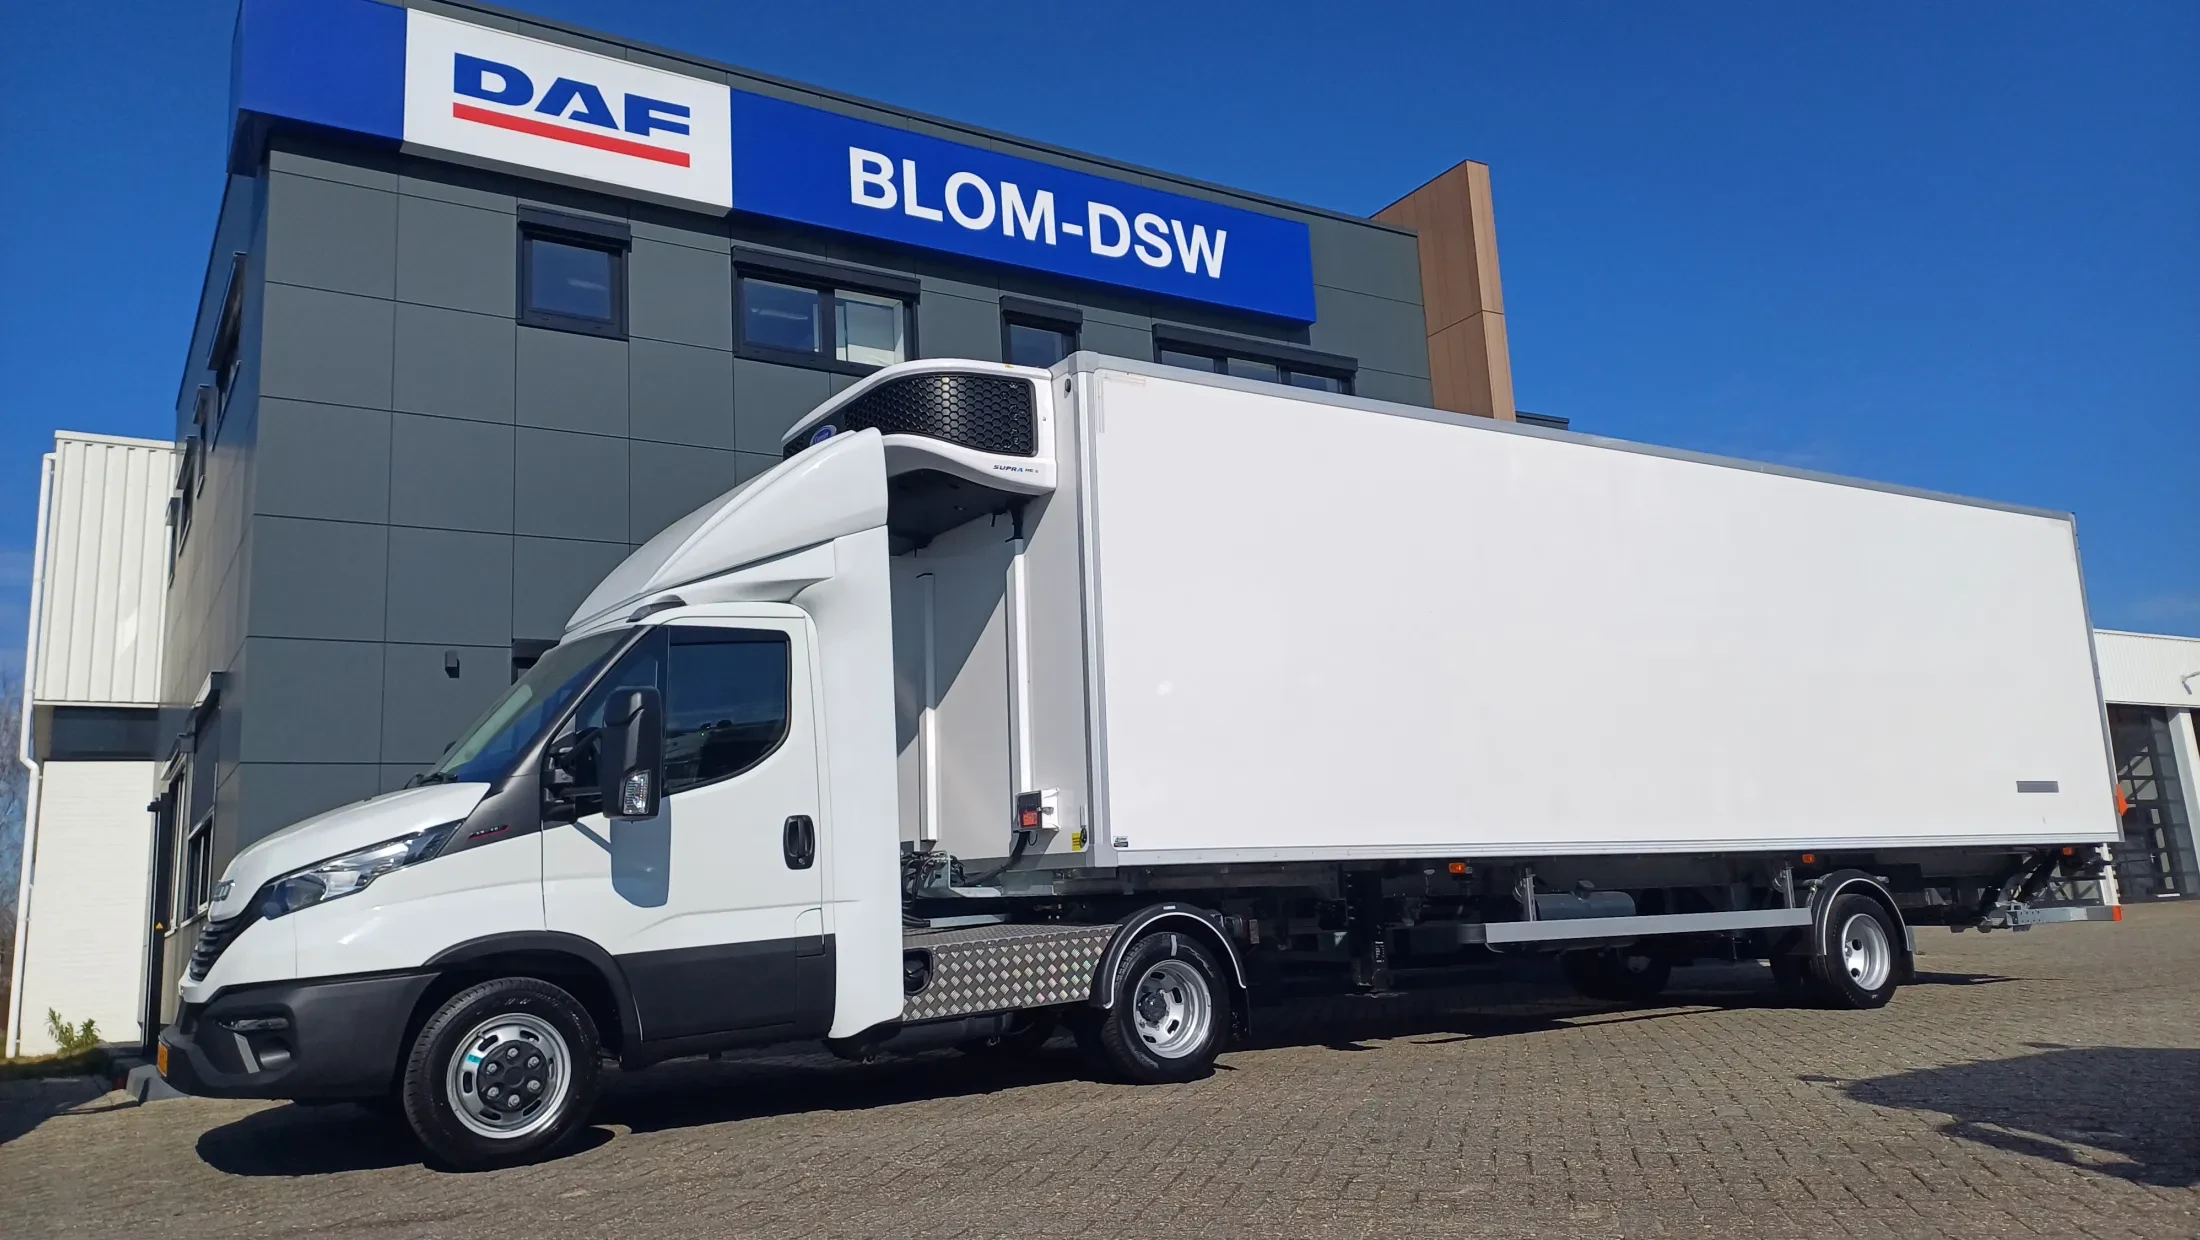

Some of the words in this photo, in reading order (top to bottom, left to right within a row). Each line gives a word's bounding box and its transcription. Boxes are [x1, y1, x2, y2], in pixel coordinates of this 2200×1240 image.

[453, 52, 690, 136] DAF
[850, 147, 1227, 279] BLOM-DSW
[993, 464, 1024, 473] SUPRA
